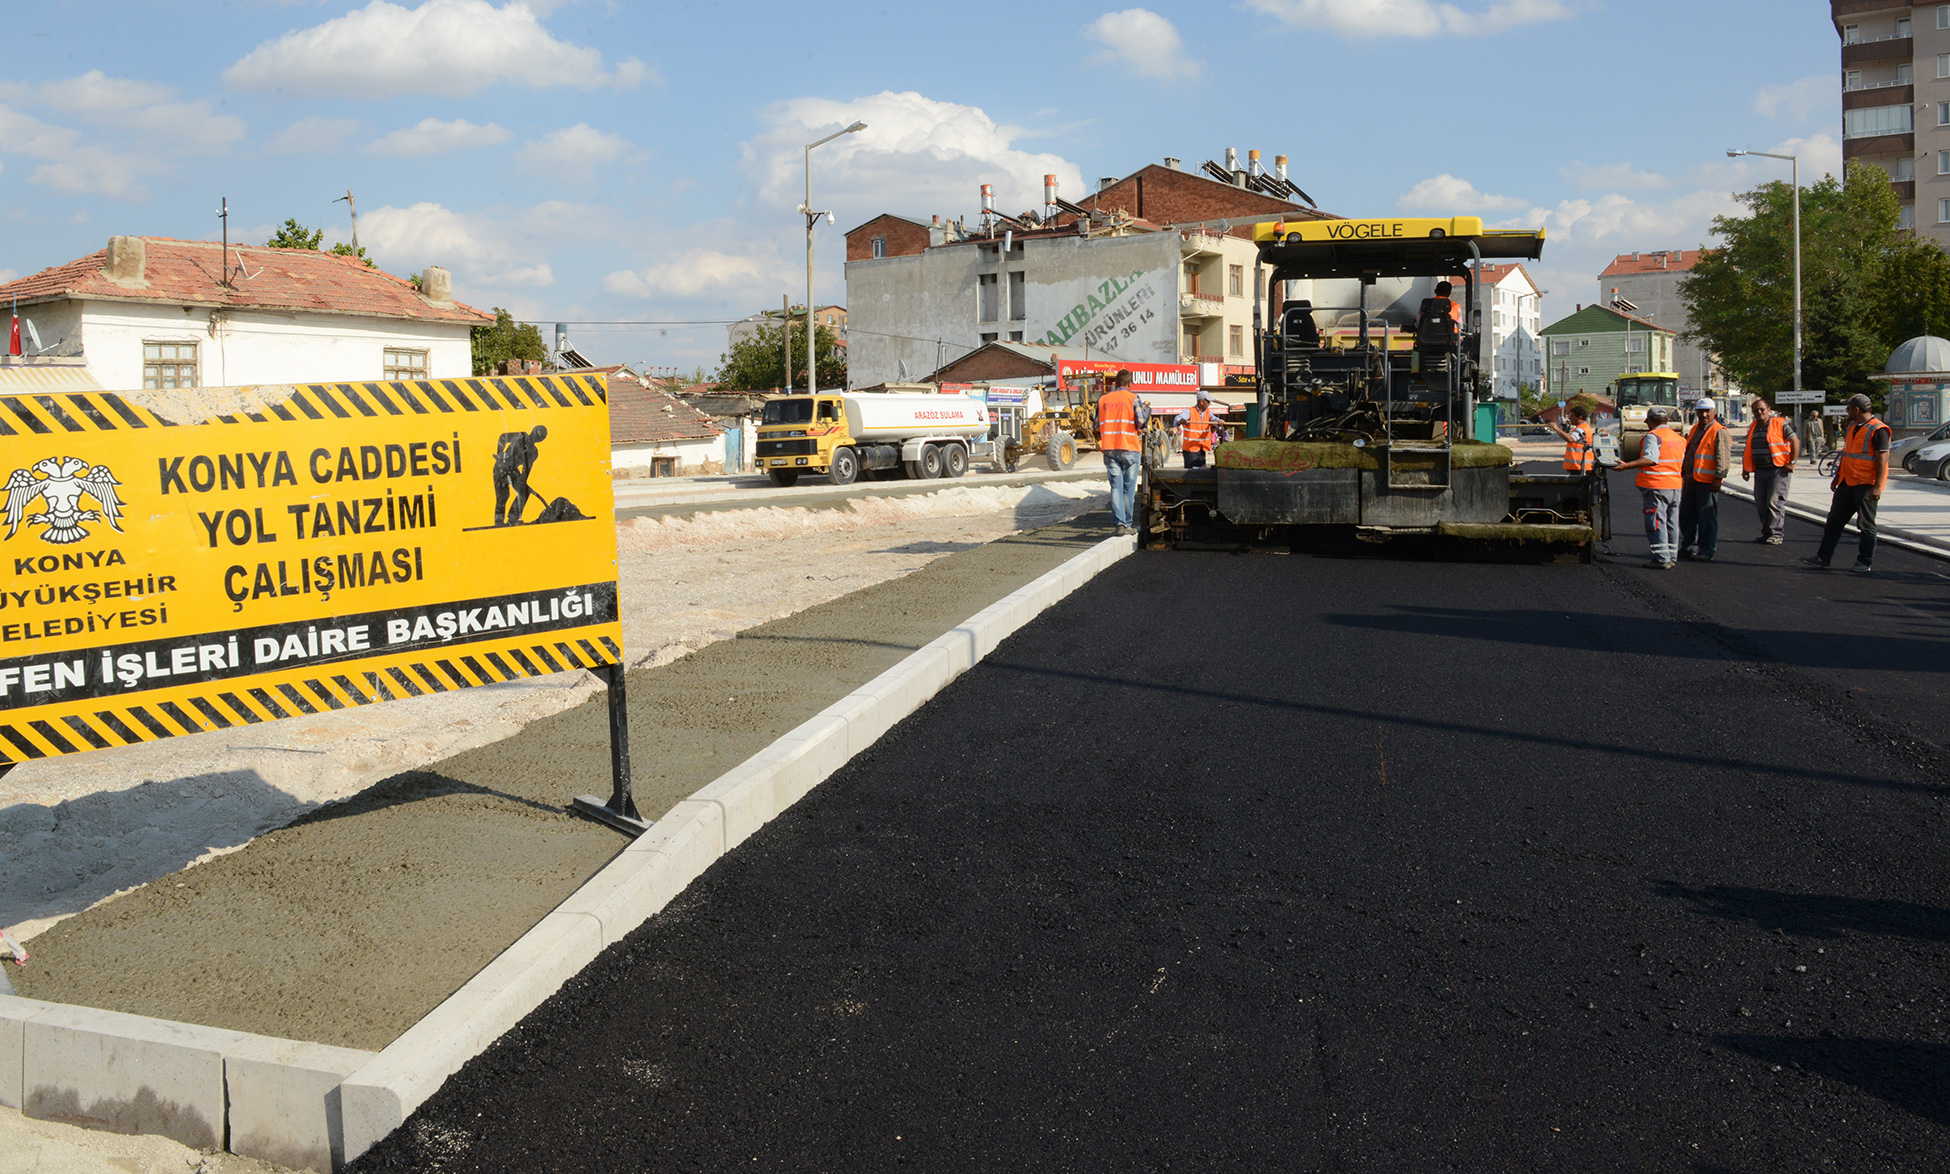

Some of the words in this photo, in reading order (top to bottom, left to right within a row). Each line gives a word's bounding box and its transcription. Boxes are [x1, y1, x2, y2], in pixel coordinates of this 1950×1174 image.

[1327, 222, 1403, 239] VÖGELE
[1120, 322, 1137, 339] 36
[1139, 309, 1155, 325] 14
[1132, 371, 1153, 384] UNLU
[1155, 370, 1197, 386] MAMÜLLERİ
[914, 409, 939, 420] ARAZÖZ
[940, 411, 964, 420] SULAMA
[158, 450, 298, 495] KONYA
[309, 431, 462, 484] CADDESİ
[198, 507, 277, 548] YOL
[287, 485, 437, 540] TANZİMİ
[14, 549, 127, 576] KONYA
[224, 547, 424, 613] ÇALIŞMASI
[0, 660, 86, 697] FEN
[101, 636, 239, 688] İŞLERİ
[254, 626, 370, 665] DAİRE
[387, 590, 593, 644] BAŞKANLIĞI
